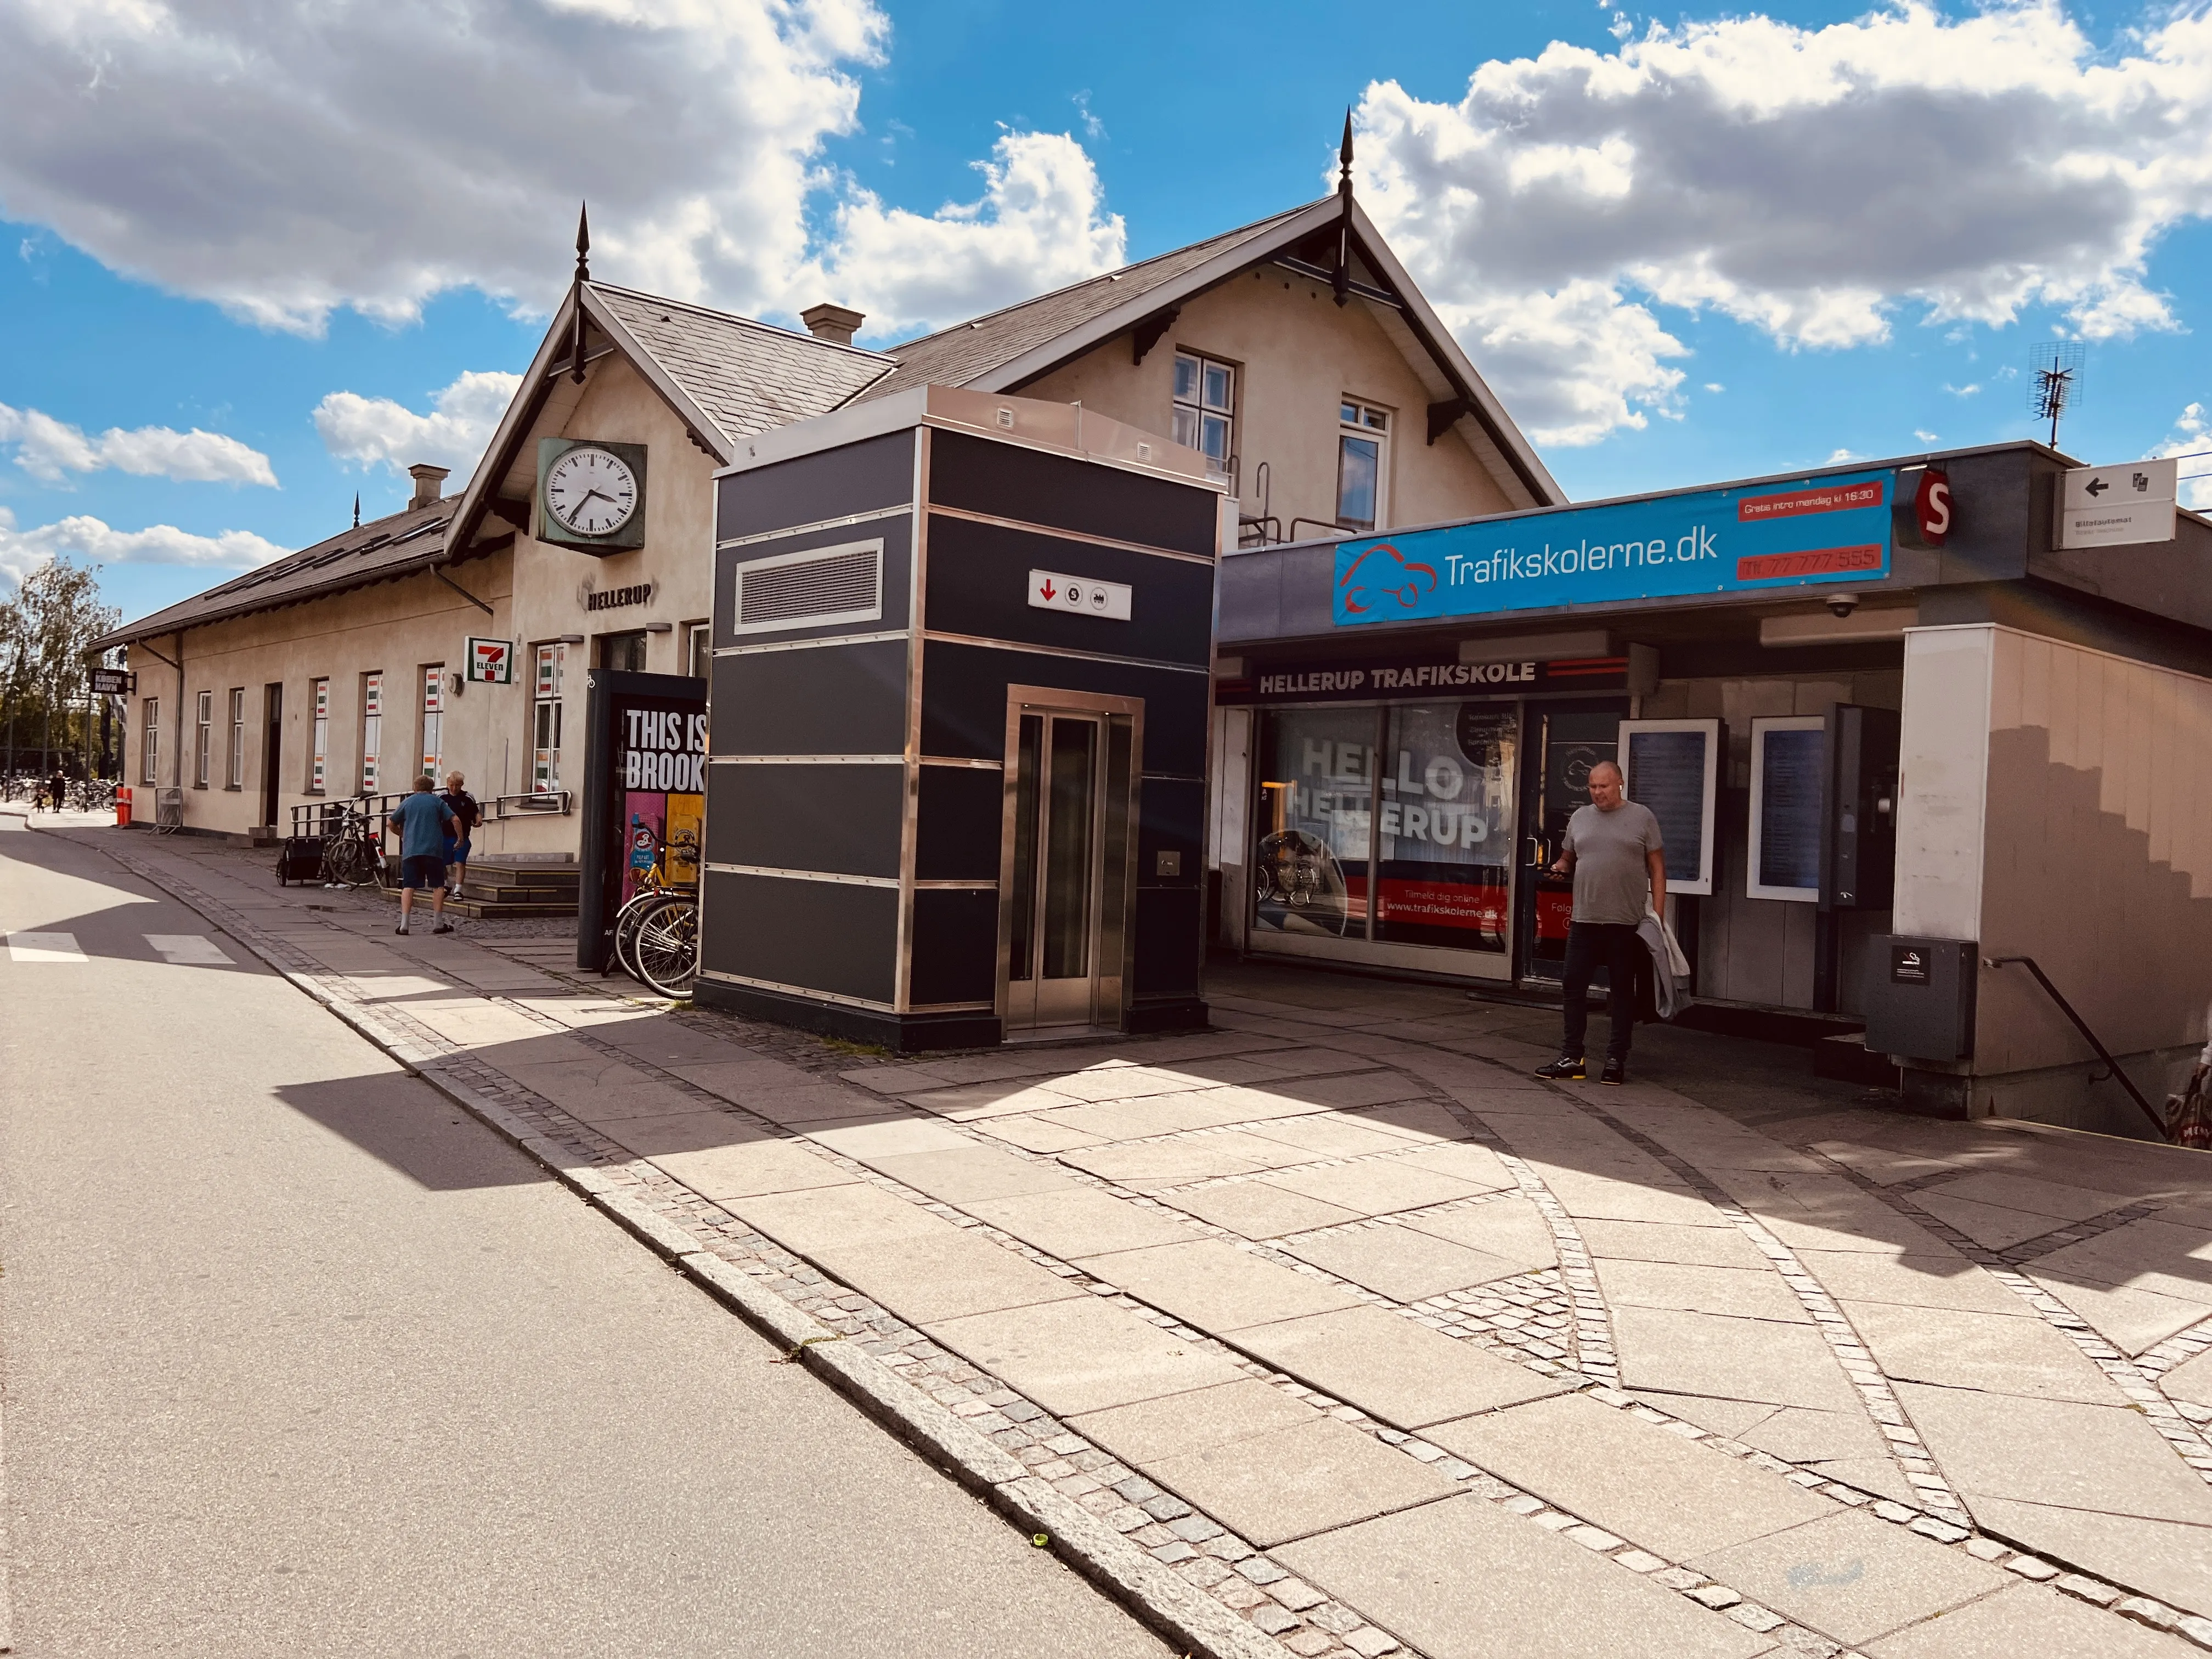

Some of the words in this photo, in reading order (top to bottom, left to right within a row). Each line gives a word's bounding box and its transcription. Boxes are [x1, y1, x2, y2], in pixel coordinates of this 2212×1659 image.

[1745, 504, 1771, 514] Gratis
[1773, 501, 1794, 510] intro
[1796, 496, 1832, 506] mandag
[1926, 483, 1949, 534] S
[1444, 524, 1718, 586] Trafikskolerne.dk
[588, 589, 652, 611] HELLERUP
[477, 645, 504, 681] 7
[1260, 670, 1365, 693] HELLERUP
[1370, 662, 1536, 689] TRAFIKSKOLE
[627, 709, 681, 751] THIS
[687, 714, 706, 752] IS
[1387, 902, 1498, 920] www.trafikskolerne.dk
[1404, 889, 1435, 900] Tilmeld
[1437, 892, 1451, 903] dig
[1453, 894, 1480, 904] online
